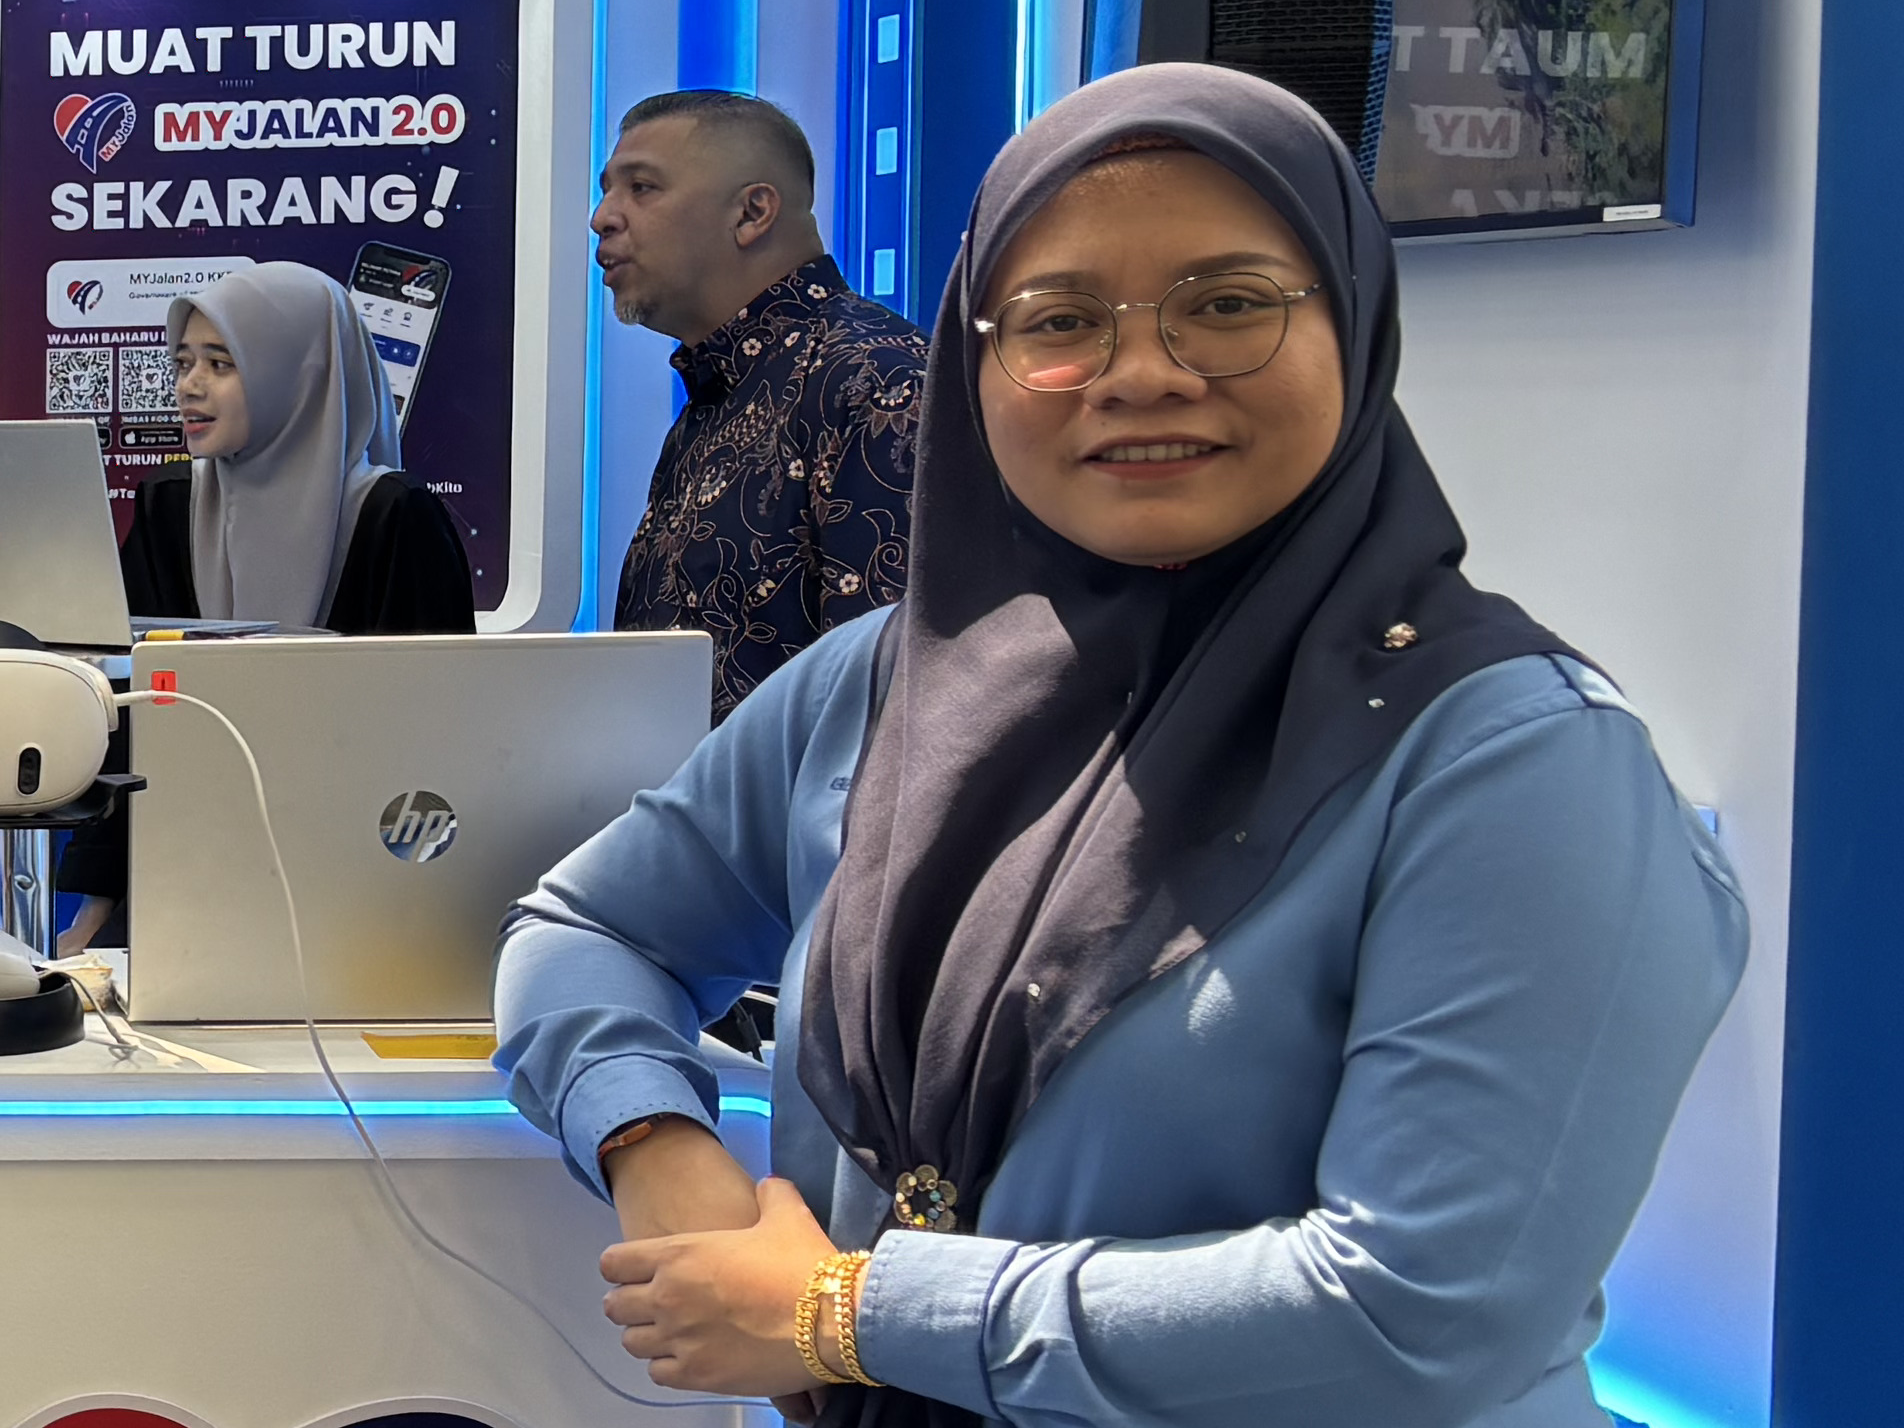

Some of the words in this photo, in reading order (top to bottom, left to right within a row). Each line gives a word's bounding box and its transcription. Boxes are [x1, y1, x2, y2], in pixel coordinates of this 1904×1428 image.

[50, 26, 233, 77] MUAT
[244, 20, 456, 70] TURUN
[162, 104, 381, 143] MYJALAN
[392, 102, 457, 136] 2.0
[50, 165, 460, 232] SEKARANG!
[47, 332, 99, 345] WAJAH
[102, 331, 159, 344] BAHARU
[114, 454, 162, 466] TURUN
[386, 791, 452, 863] hp
